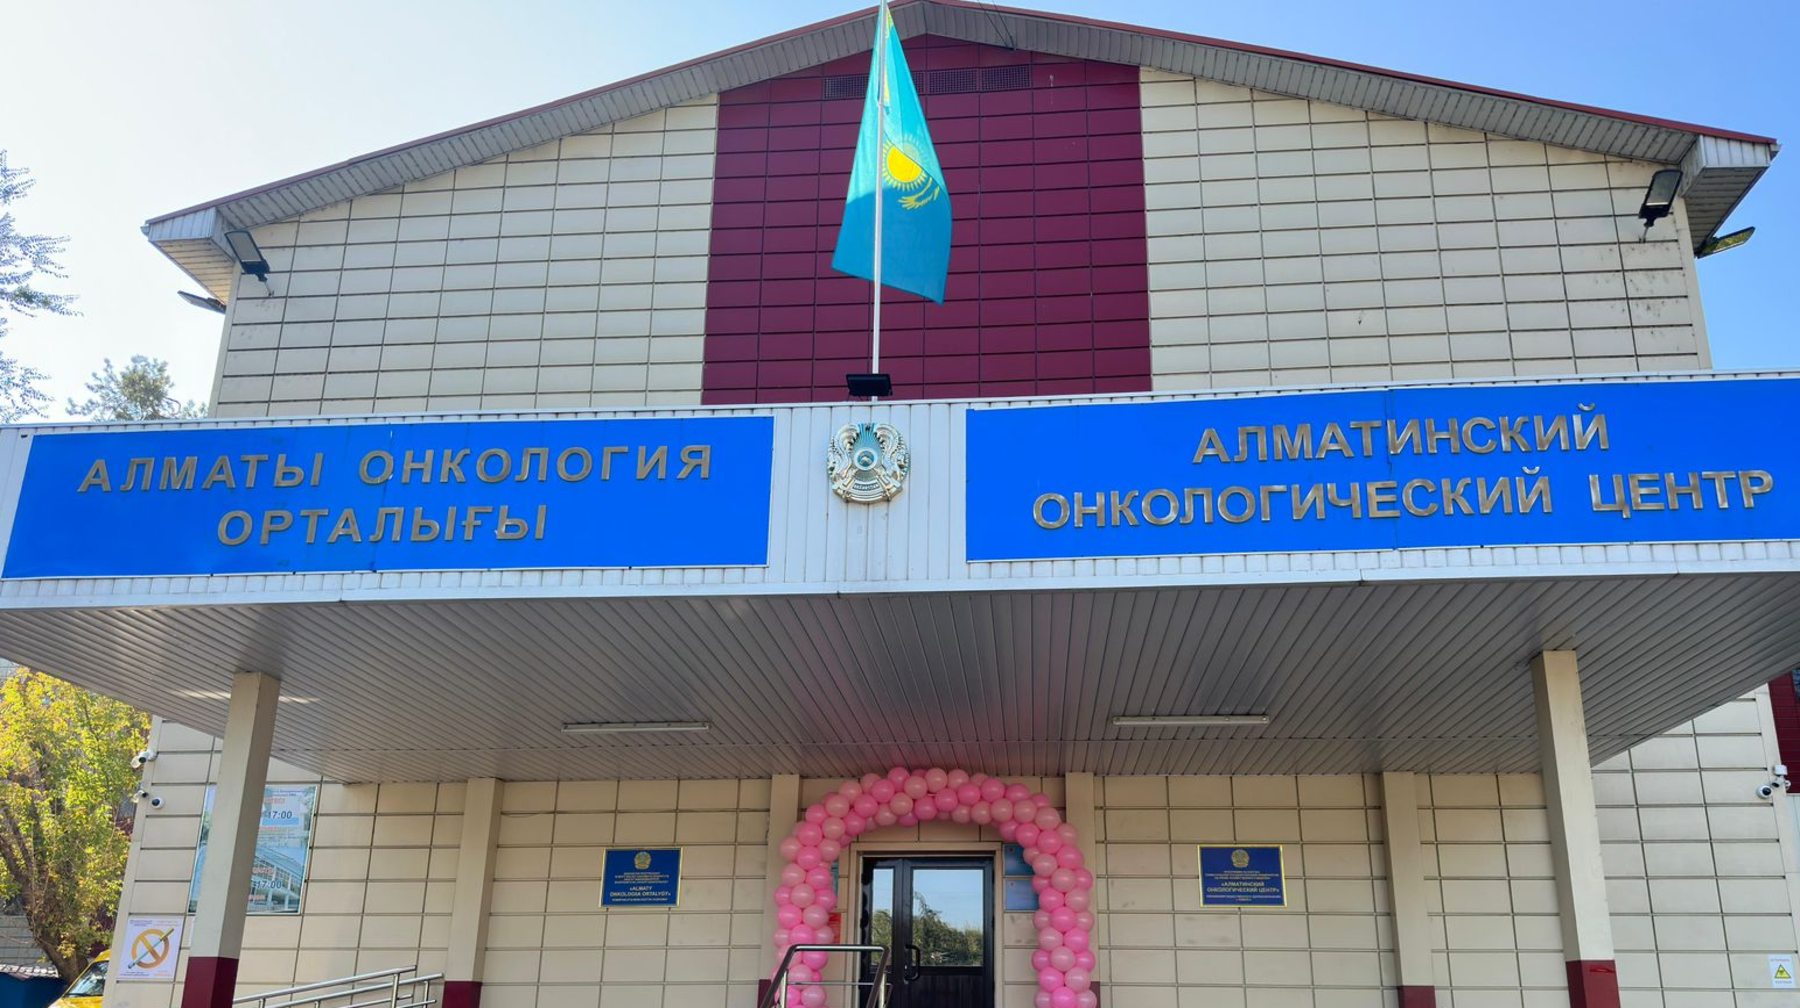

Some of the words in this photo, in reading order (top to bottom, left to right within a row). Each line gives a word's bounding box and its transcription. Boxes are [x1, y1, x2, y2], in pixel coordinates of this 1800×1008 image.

[1194, 404, 1609, 463] АЛМАТИНСКИЙ
[79, 454, 323, 493] АЛМАТЫ
[360, 446, 710, 485] ОНКОЛОГИЯ
[1034, 467, 1552, 529] ОНКОЛОГИЧЕСКИЙ
[1590, 471, 1773, 519] ЦЕНТР
[219, 505, 546, 546] ОРТАЛЫҒЫ
